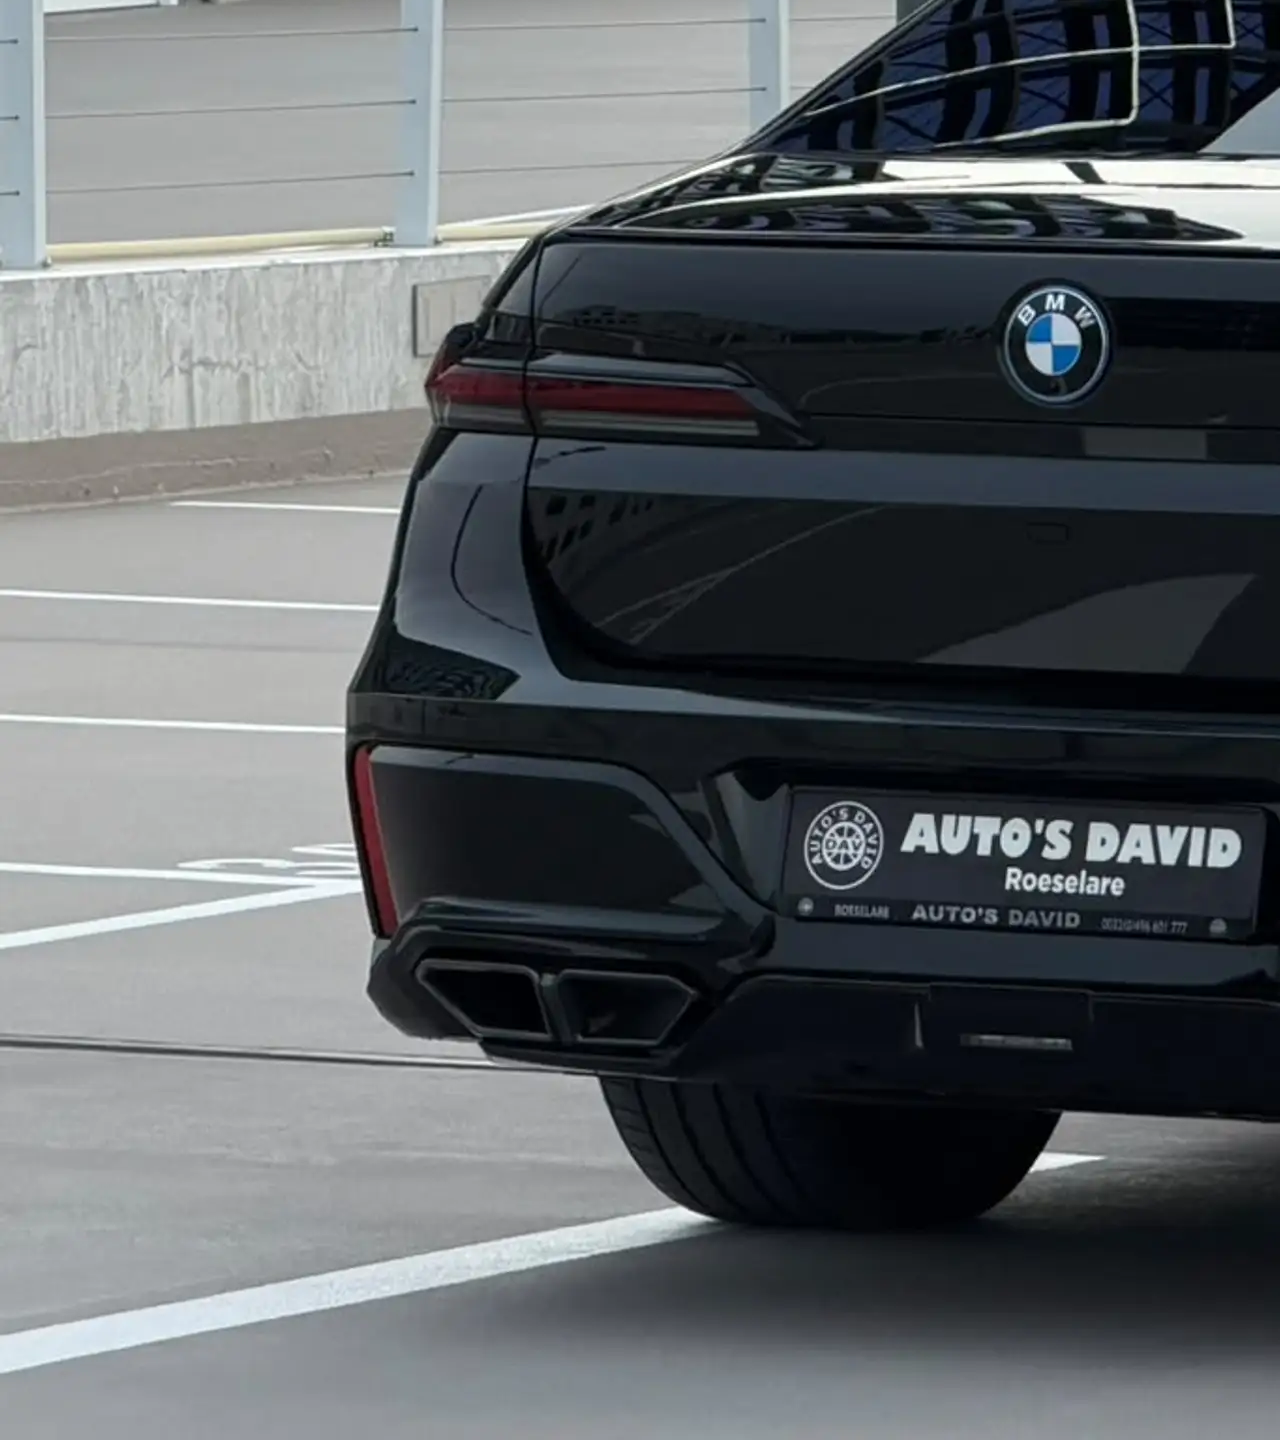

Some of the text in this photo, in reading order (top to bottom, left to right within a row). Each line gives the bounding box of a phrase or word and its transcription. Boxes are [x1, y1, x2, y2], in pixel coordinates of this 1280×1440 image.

[1017, 293, 1096, 328] BMW
[810, 807, 879, 870] AUTO'S DAVID
[900, 812, 1242, 869] AUTO'S DAVID
[1004, 866, 1126, 897] Roeselare
[911, 903, 1081, 929] AUTO'S DAVID
